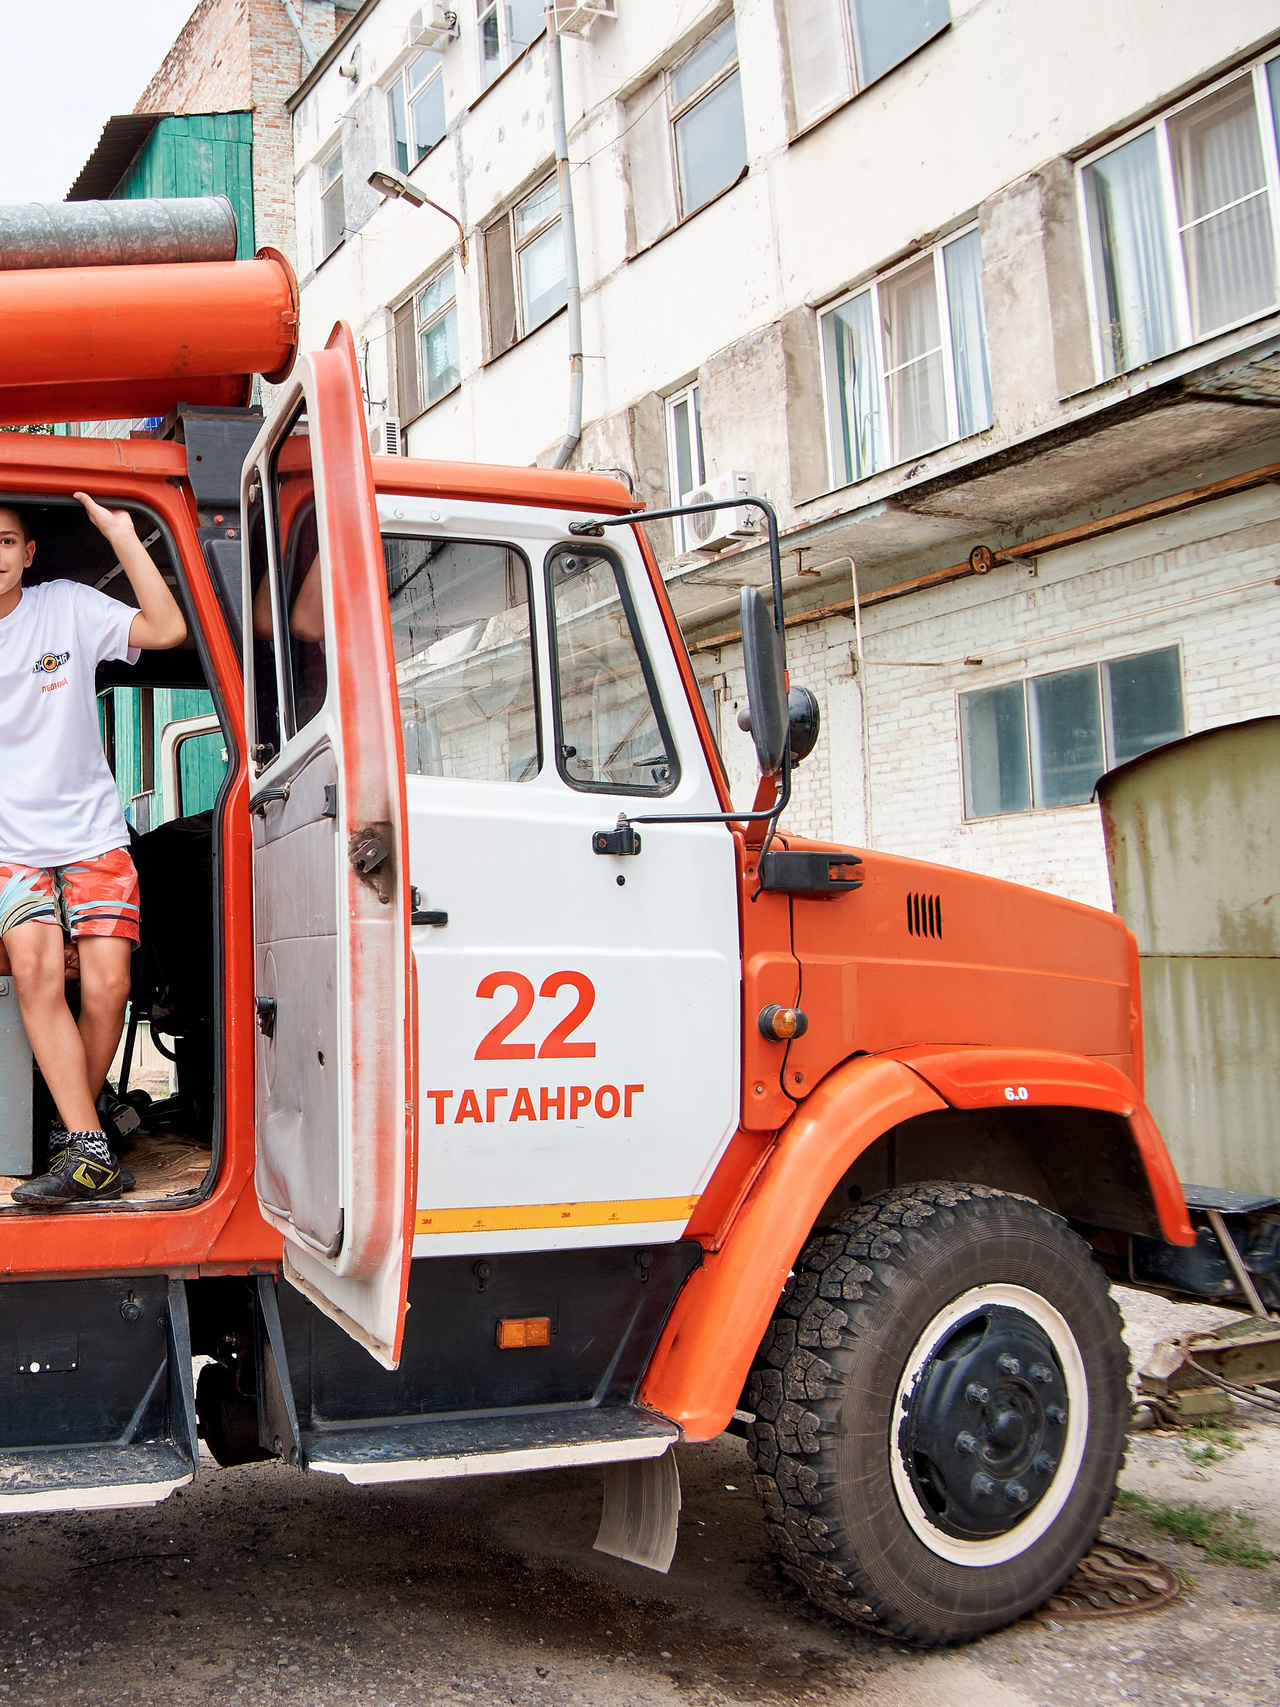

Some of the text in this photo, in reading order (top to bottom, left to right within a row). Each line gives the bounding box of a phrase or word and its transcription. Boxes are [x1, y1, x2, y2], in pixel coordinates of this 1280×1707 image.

[474, 970, 596, 1060] 22
[427, 1084, 644, 1125] ТАГАНРОГ
[1004, 1086, 1028, 1101] 6.0
